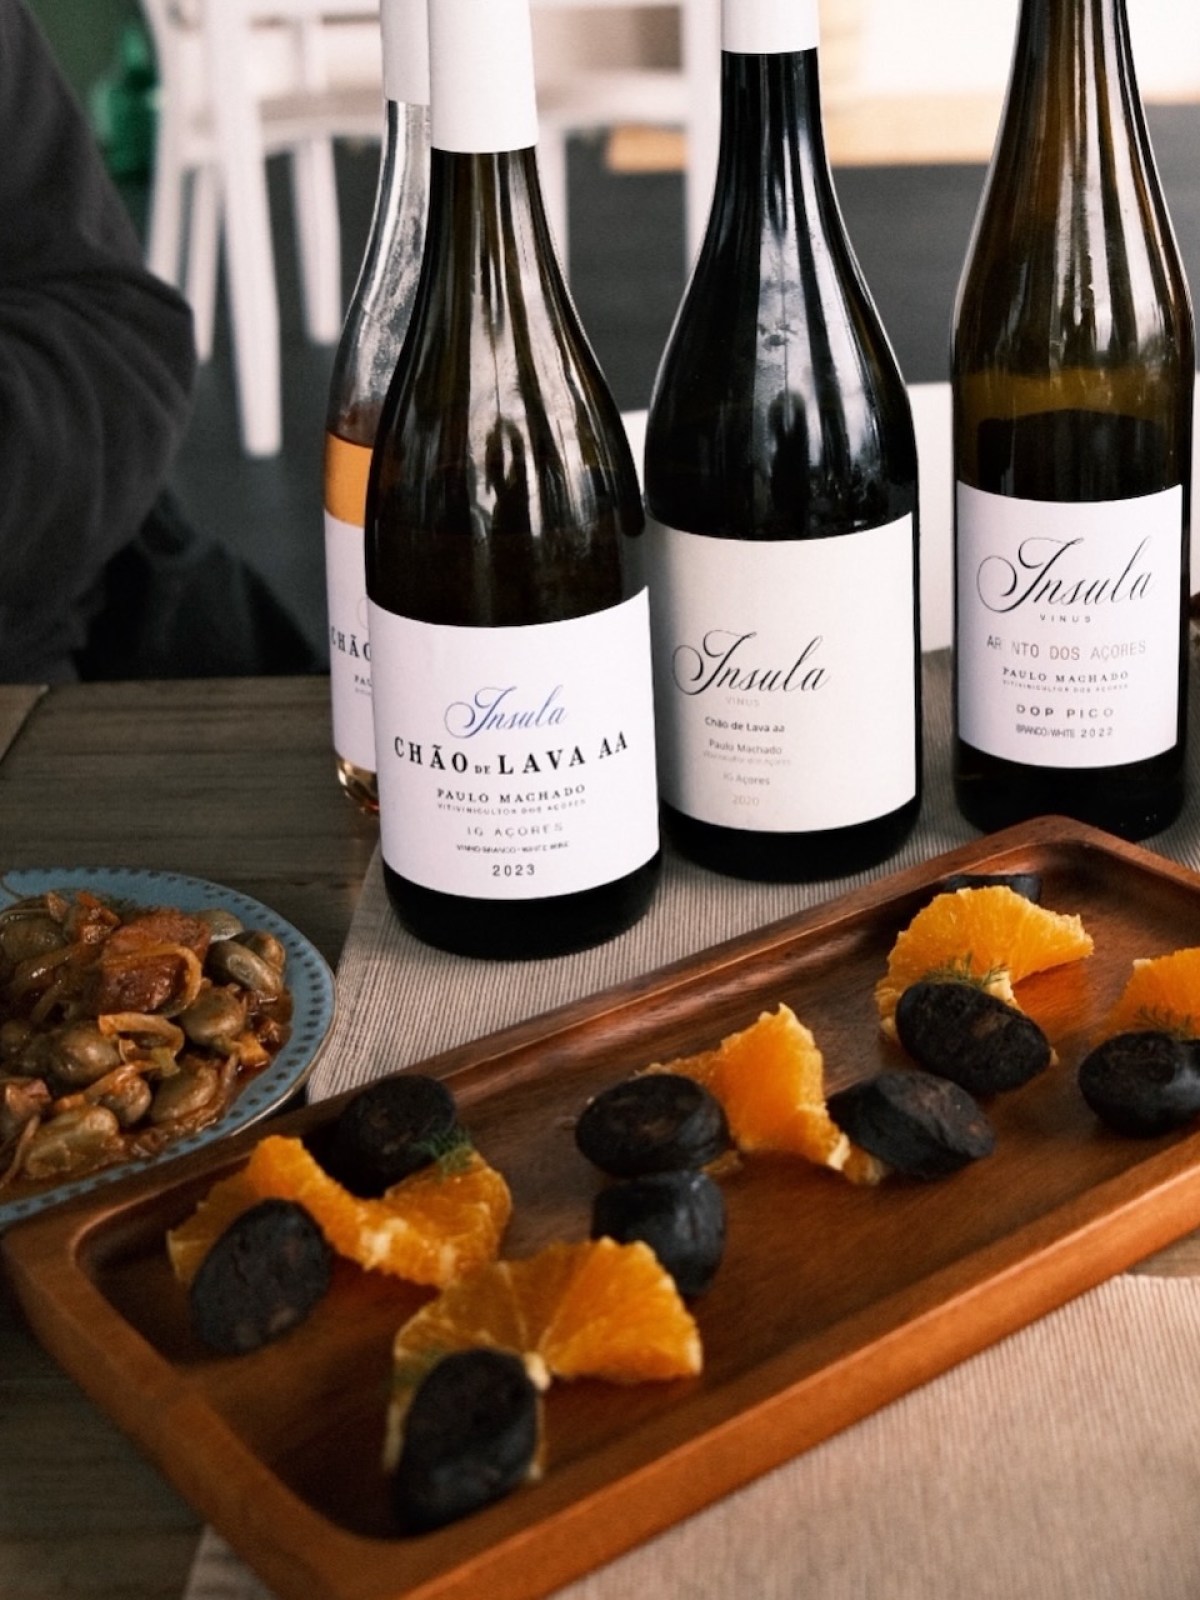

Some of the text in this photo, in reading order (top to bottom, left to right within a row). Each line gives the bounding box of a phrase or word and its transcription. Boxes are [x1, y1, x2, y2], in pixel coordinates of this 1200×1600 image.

[976, 534, 1155, 614] Insula
[1039, 614, 1092, 623] VINUS
[1049, 645, 1080, 661] DOS
[1090, 639, 1146, 661] AÇORES
[672, 629, 831, 696] Insula
[1002, 666, 1128, 683] PAULO MACHADO
[443, 684, 567, 739] Insula
[1016, 704, 1114, 719] DOP PICO
[730, 721, 744, 731] de
[746, 723, 770, 732] Lava
[772, 724, 785, 732] aa
[1080, 726, 1113, 738] 2022
[394, 731, 628, 775] CHÃO DE LAVA AA
[709, 738, 782, 755] Paulo Machado
[437, 784, 586, 804] PAULO MACHADO
[494, 823, 563, 838] AÇORES
[492, 864, 536, 877] 2023
